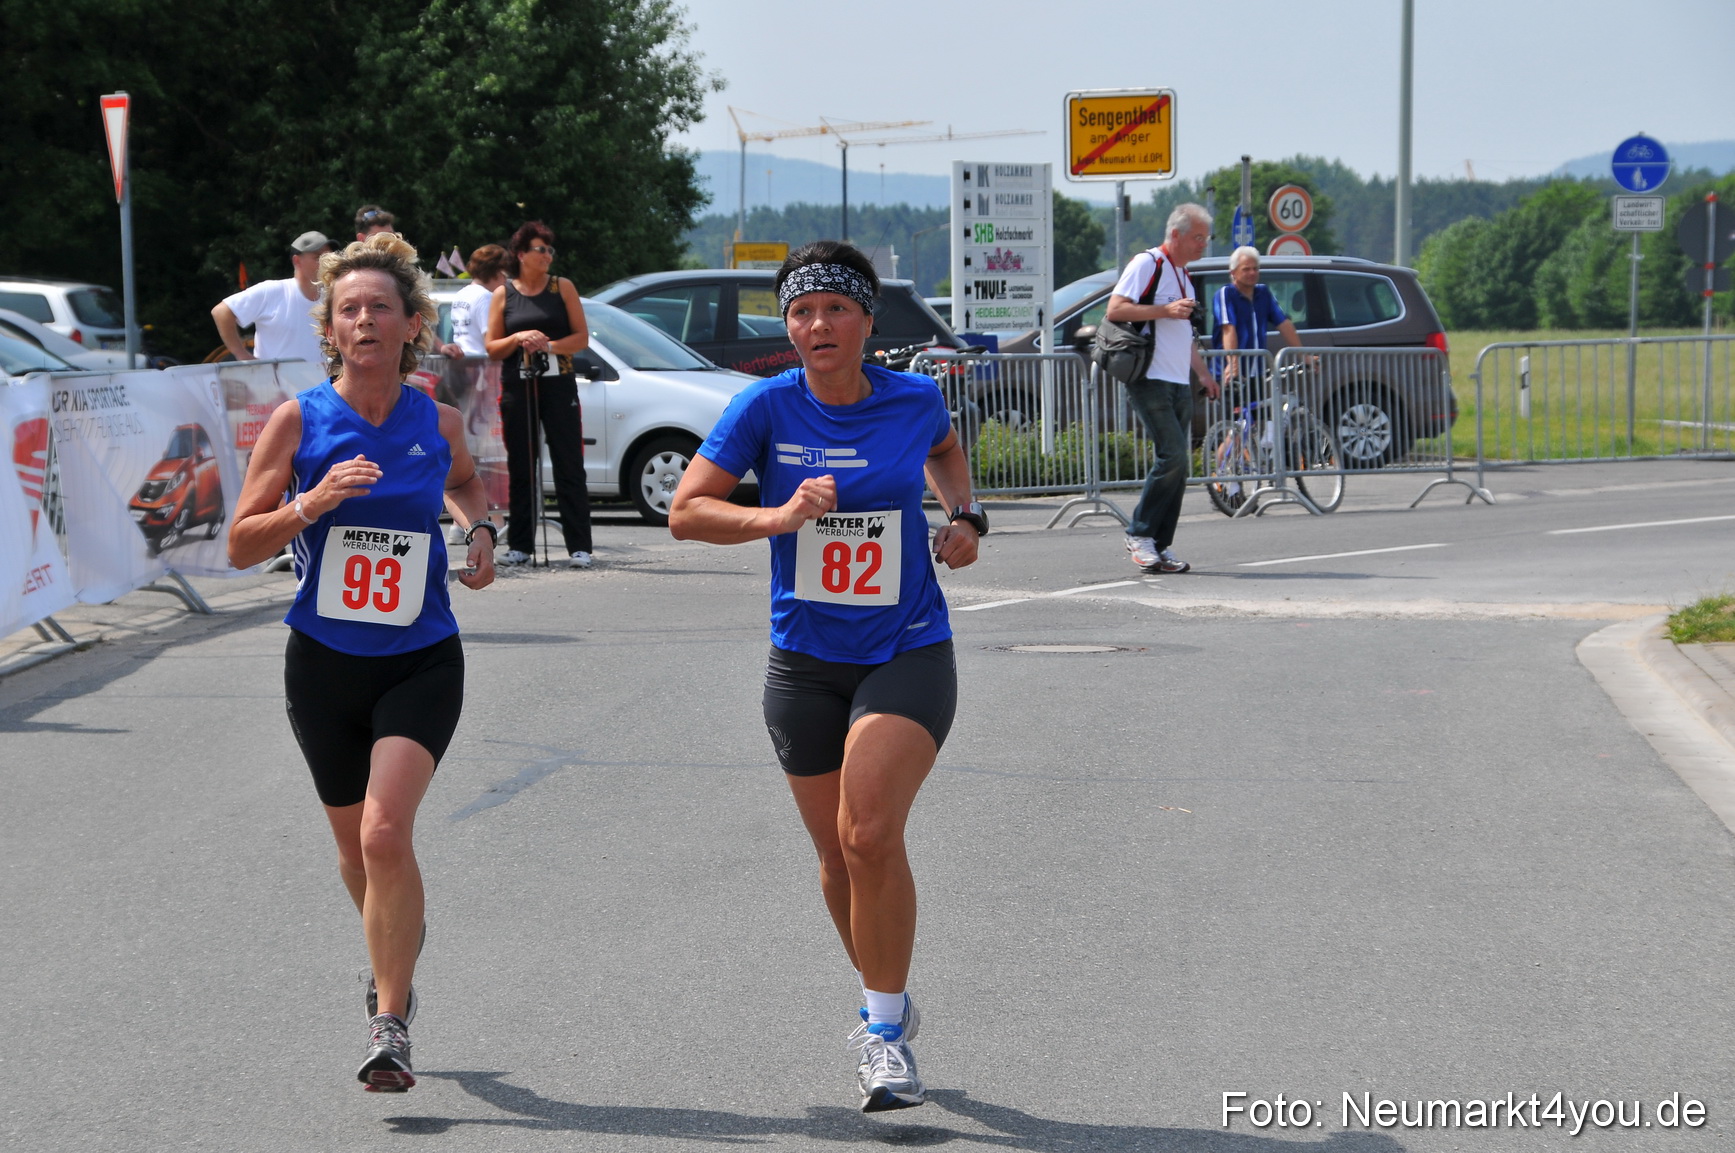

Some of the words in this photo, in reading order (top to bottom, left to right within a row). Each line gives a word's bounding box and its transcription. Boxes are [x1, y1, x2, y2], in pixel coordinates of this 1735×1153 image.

[1079, 105, 1162, 131] Sengenthal
[1090, 134, 1109, 144] am
[1114, 131, 1151, 146] Anger
[1099, 153, 1136, 165] Neumarkt
[1281, 199, 1303, 219] 60
[974, 222, 994, 244] SHB
[995, 226, 1034, 241] Holzfachmarkt
[974, 280, 1007, 300] THULE
[974, 306, 1034, 319] HEIDELBERGCEMENT
[731, 349, 801, 374] Vertriebsp
[71, 388, 88, 411] KIA
[815, 517, 865, 529] MEYER
[815, 527, 865, 538] WERBUNG
[342, 540, 390, 553] WERBUNG
[343, 530, 391, 545] MEYER
[821, 541, 883, 595] 82
[342, 554, 402, 613] 93
